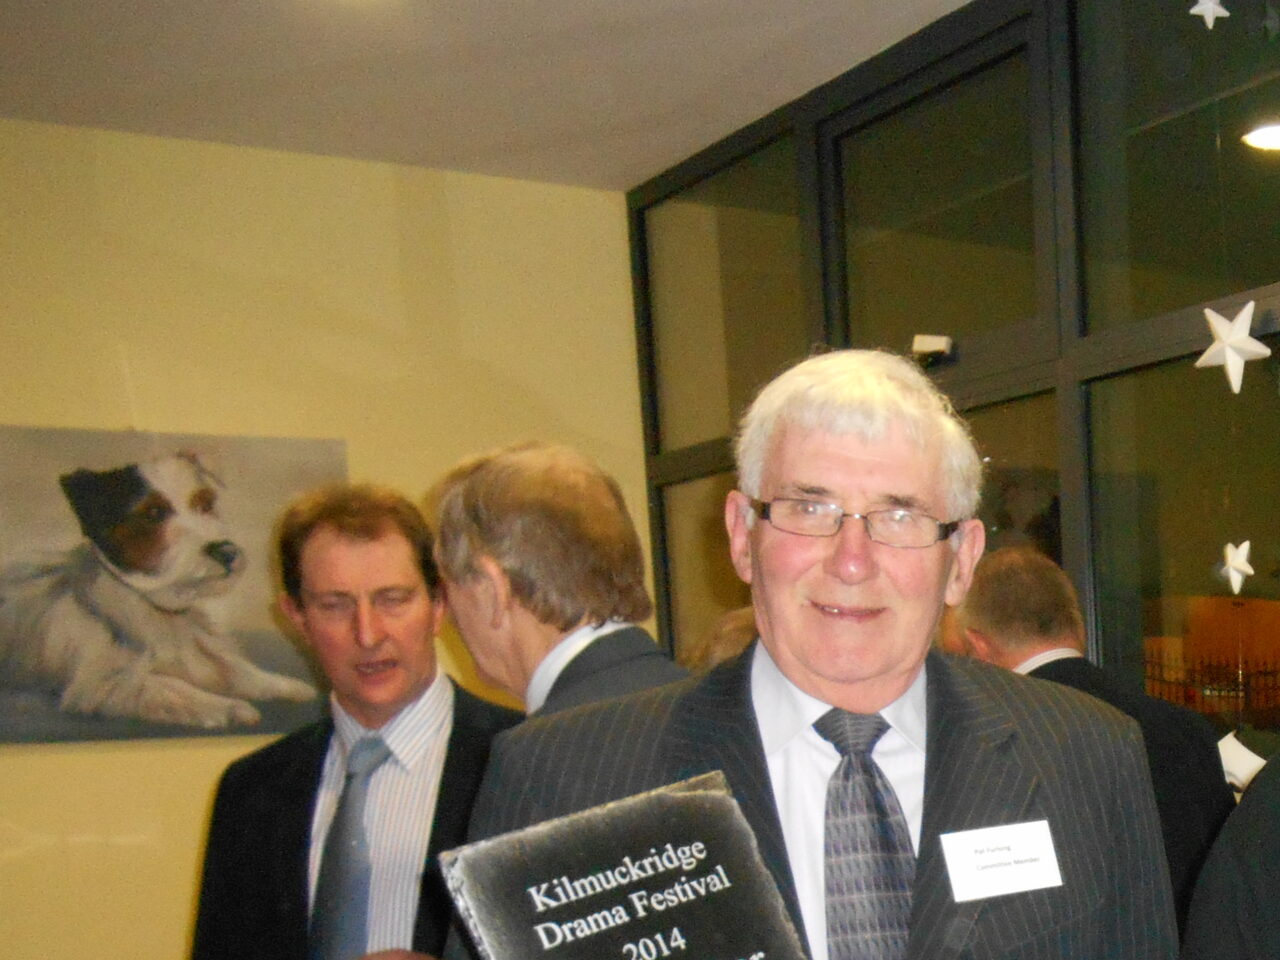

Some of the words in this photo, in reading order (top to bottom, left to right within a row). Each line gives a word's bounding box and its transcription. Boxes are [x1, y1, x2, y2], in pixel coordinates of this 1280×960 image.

[527, 841, 707, 912] Kilmuckridge
[533, 905, 630, 950] Drama
[628, 865, 732, 917] Festival
